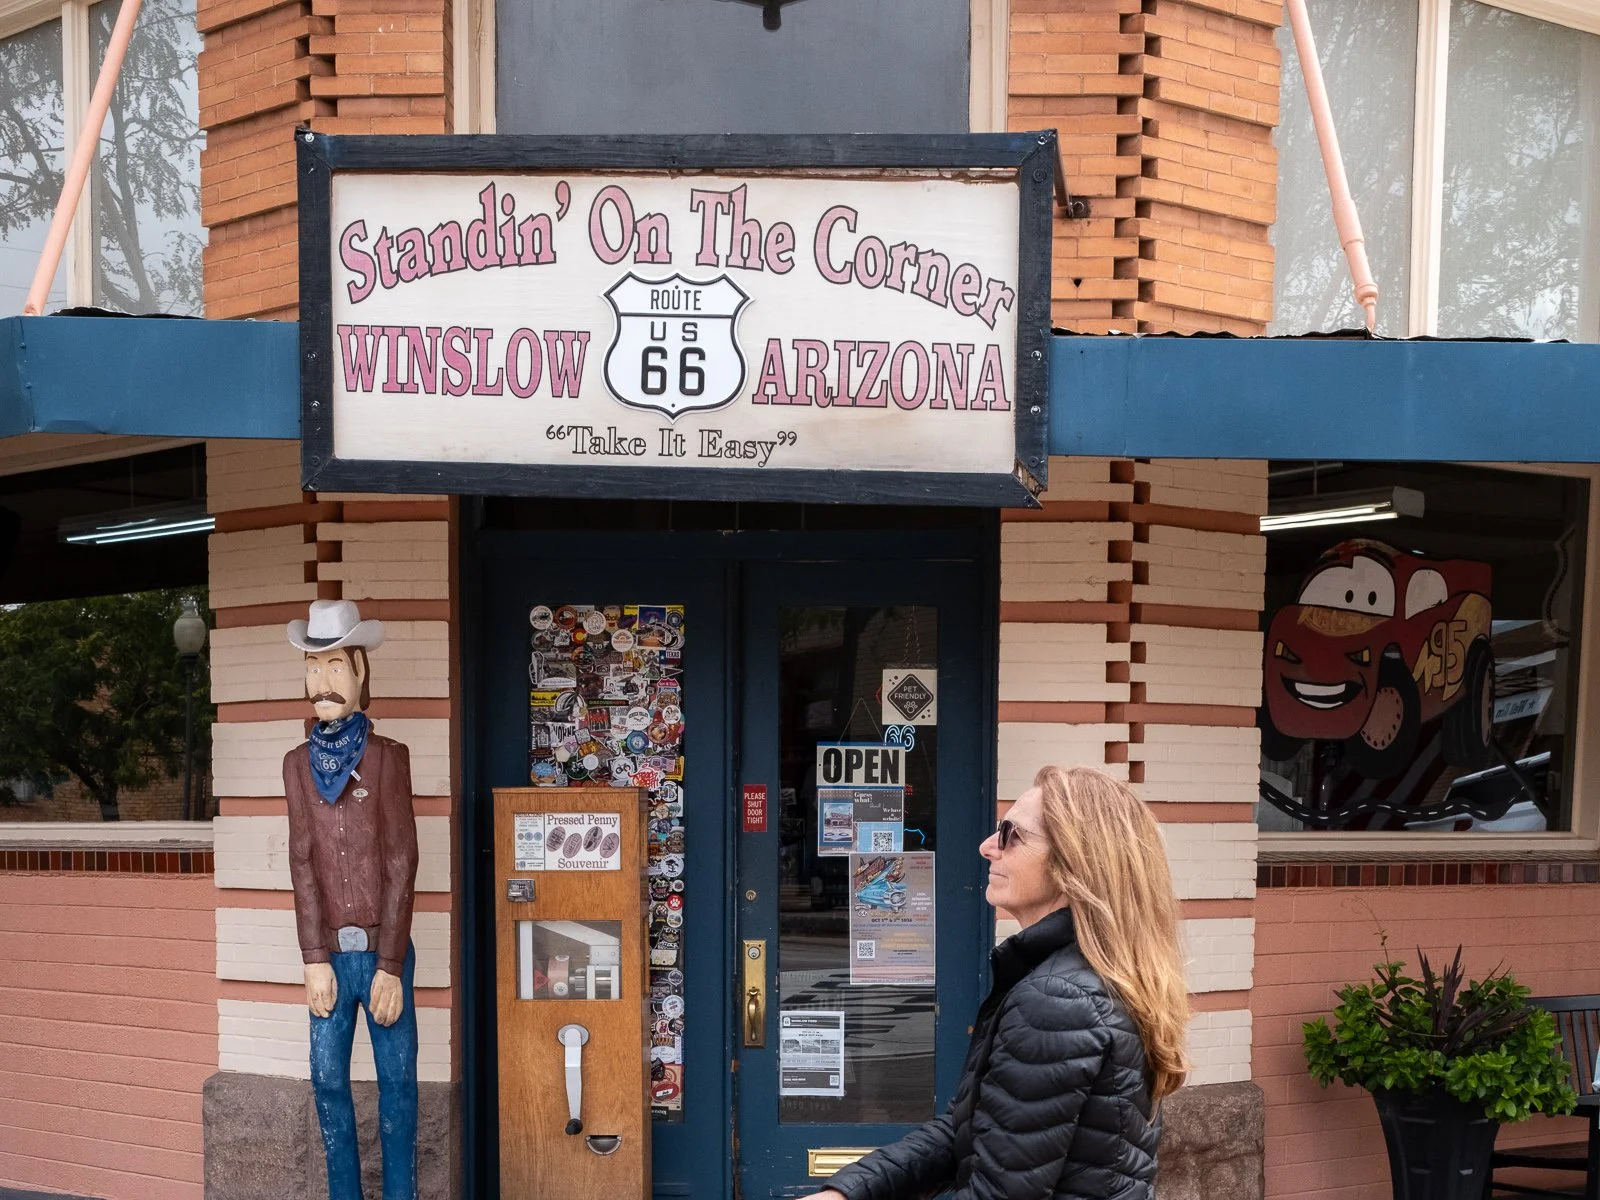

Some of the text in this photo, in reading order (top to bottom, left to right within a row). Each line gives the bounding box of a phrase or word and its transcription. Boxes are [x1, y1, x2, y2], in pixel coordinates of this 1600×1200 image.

[339, 180, 1016, 332] Standin’ On The Corner
[650, 289, 703, 311] ROUTE
[336, 323, 591, 399] WINSLOW
[640, 345, 706, 397] 66
[751, 337, 1012, 412] ARIZONA
[546, 424, 798, 468] “Take It Easy”
[666, 650, 680, 658] TEXAS
[1430, 619, 1468, 688] 95
[894, 692, 927, 700] FRIENDLY
[334, 735, 351, 749] EASY
[884, 724, 916, 752] 66
[322, 758, 337, 770] 66
[822, 747, 900, 784] OPEN
[744, 792, 766, 800] PLEASE
[747, 800, 763, 808] SHUT
[747, 808, 763, 816] DOOR
[546, 814, 585, 825] Pressed
[587, 814, 618, 828] Penny
[746, 816, 763, 824] TIGHT
[557, 858, 609, 869] Souvenir
